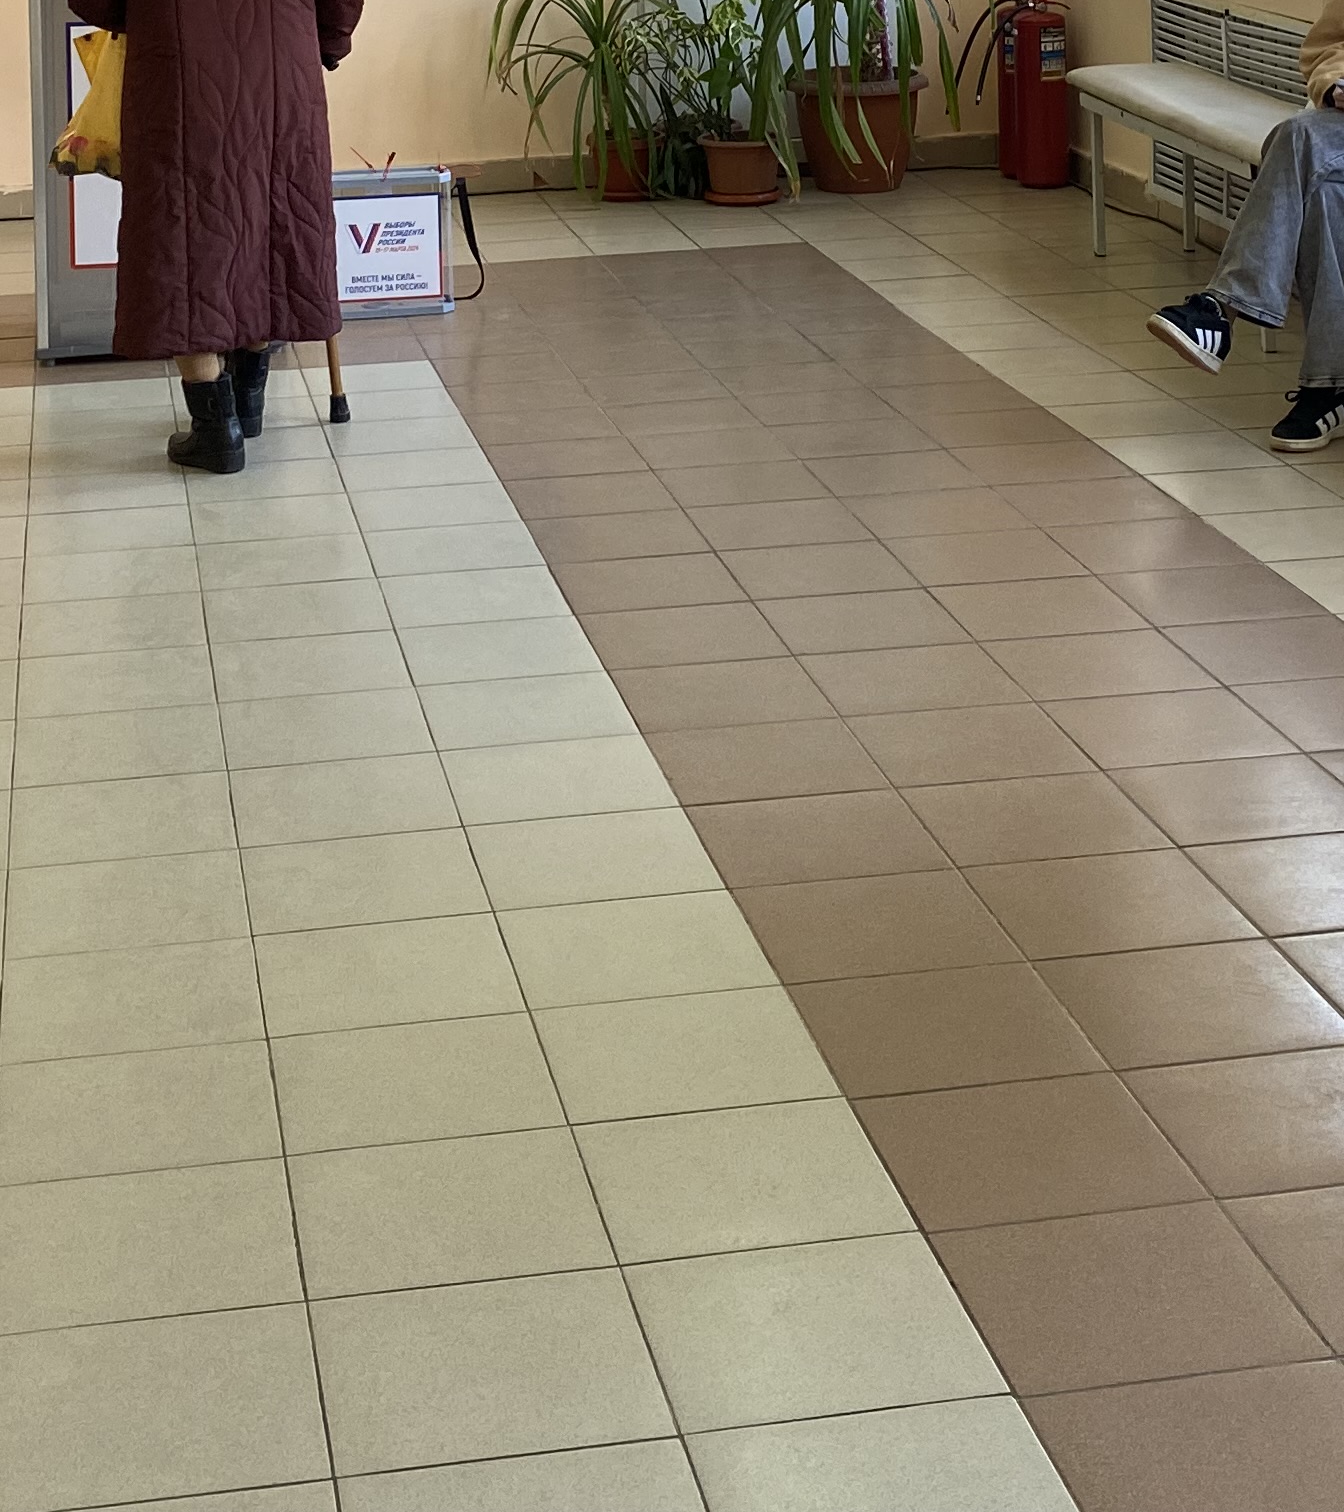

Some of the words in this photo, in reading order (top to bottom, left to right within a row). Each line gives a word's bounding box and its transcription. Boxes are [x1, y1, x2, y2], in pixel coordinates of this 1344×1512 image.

[384, 221, 416, 229] ВЫБОРЫ
[380, 229, 425, 238] ПРЕЗИДЕНТА
[377, 238, 407, 246] РОССИИ
[351, 274, 379, 284] ВМЕСТЕ
[381, 274, 394, 282] МЫ
[396, 273, 415, 281] СИЛА
[345, 285, 384, 295] ГОЛОСУЕМ
[385, 284, 394, 292] ЗА
[395, 282, 429, 291] РОССИЮ!
